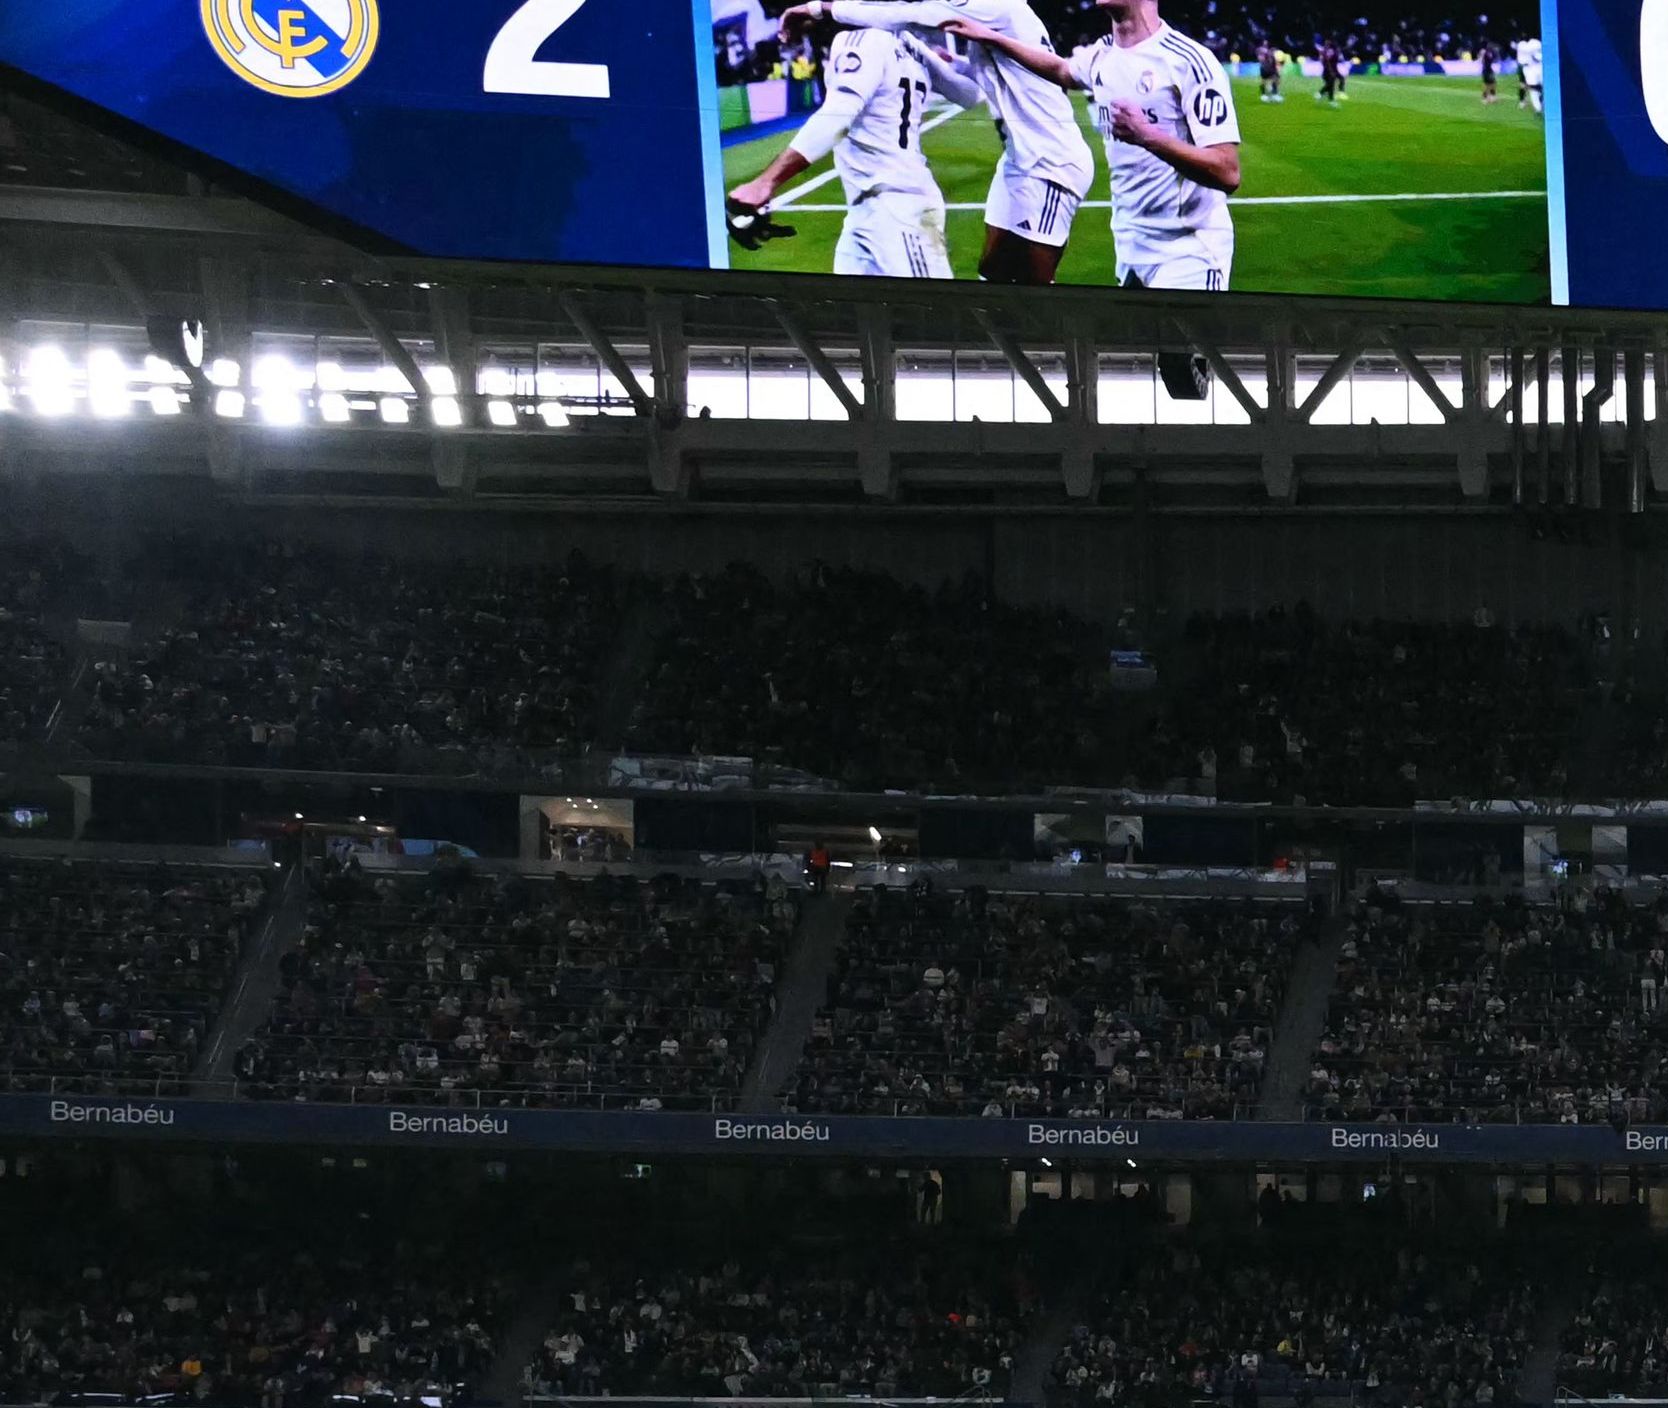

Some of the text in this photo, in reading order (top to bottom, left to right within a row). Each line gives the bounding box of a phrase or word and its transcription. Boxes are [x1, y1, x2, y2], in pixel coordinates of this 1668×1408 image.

[52, 1101, 174, 1125] Bernabéu
[390, 1111, 508, 1134] Bernabéu
[716, 1119, 830, 1141] Bernabéu
[1028, 1124, 1139, 1145] Bernabéu
[1331, 1128, 1438, 1148] Bernabéu
